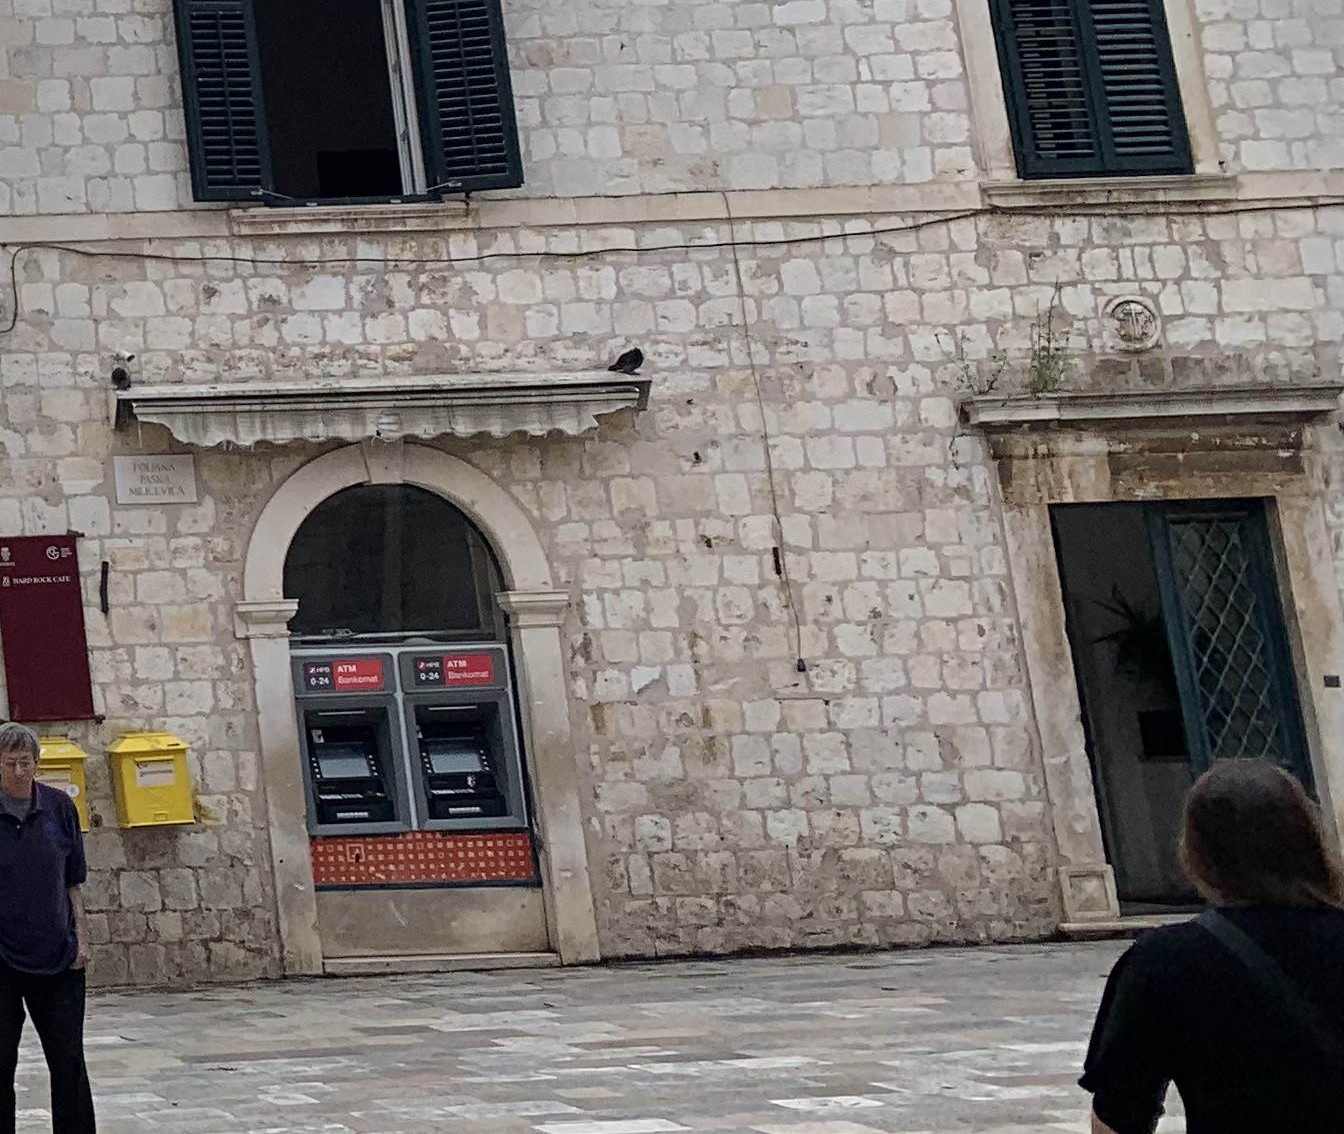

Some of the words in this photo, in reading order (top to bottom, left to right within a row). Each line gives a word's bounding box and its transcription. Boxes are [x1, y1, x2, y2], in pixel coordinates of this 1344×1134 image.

[139, 475, 171, 485] PASKA
[33, 576, 52, 584] ROCK
[337, 664, 357, 673] ATM
[447, 660, 467, 668] ATM
[310, 676, 330, 685] 0-24
[337, 674, 379, 684] Bankomat
[419, 671, 440, 681] 0-24
